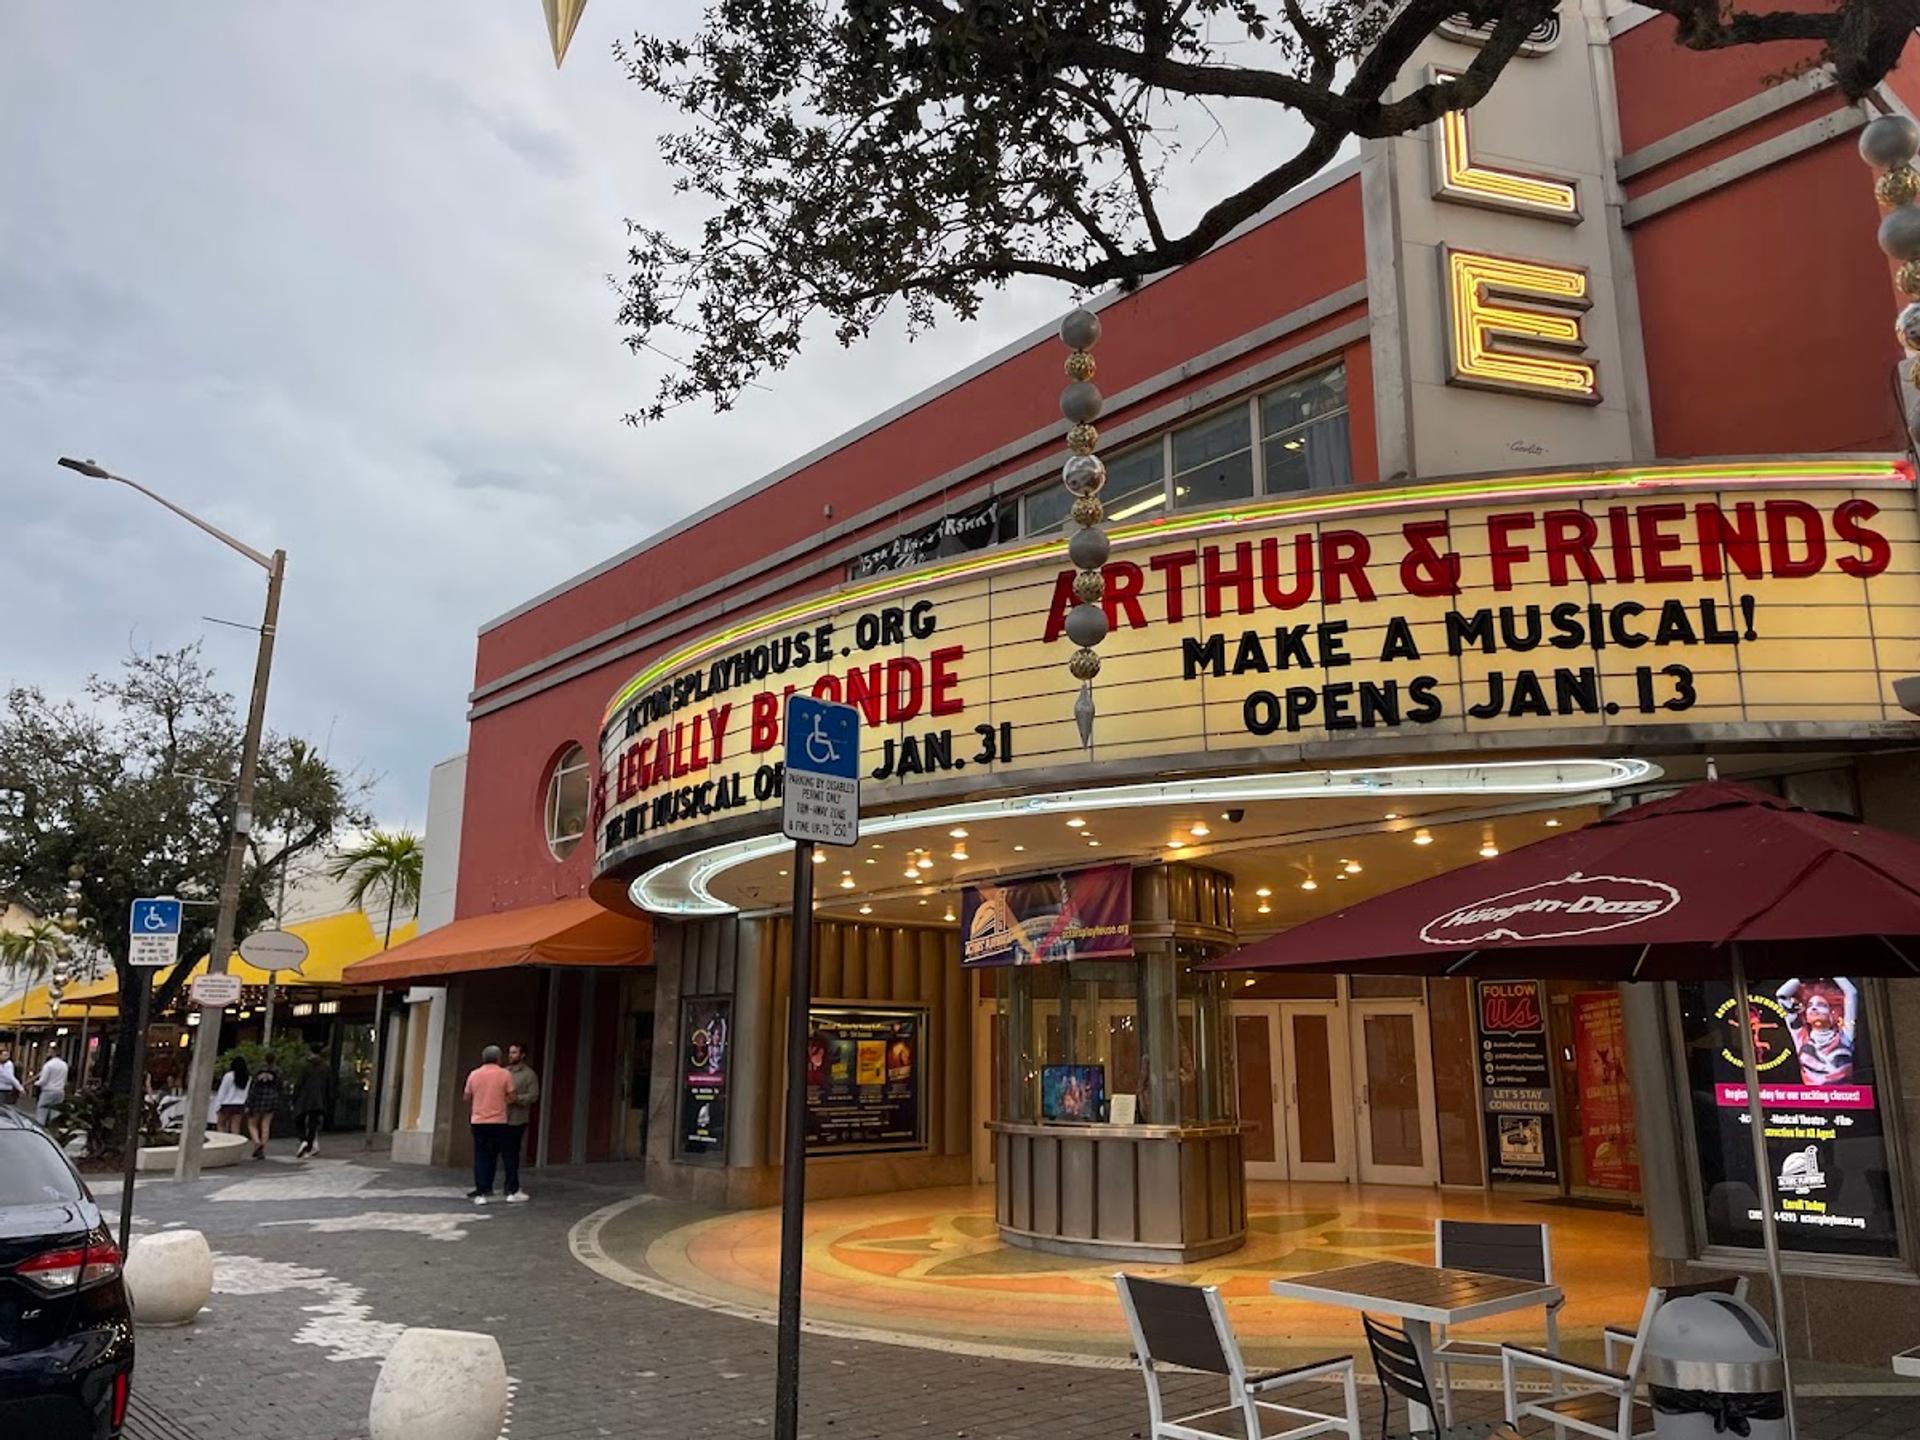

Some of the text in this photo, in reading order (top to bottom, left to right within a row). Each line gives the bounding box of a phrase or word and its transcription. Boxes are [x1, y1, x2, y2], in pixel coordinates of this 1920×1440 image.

[1043, 498, 1892, 644] ARTHUR & FRIENDS
[1182, 595, 1758, 681] MAKE A MUSICAL!
[1243, 676, 1443, 735] OPENS
[616, 703, 732, 804] LEGALLY
[751, 645, 964, 753] BNDE
[651, 772, 747, 829] MUSICAL
[802, 788, 824, 802] PERMIT
[826, 779, 855, 793] DISABLED
[1483, 984, 1536, 998] FOLLOW
[1488, 1100, 1550, 1112] CONNECTED!
[1493, 1089, 1542, 1100] LET'S STAY
